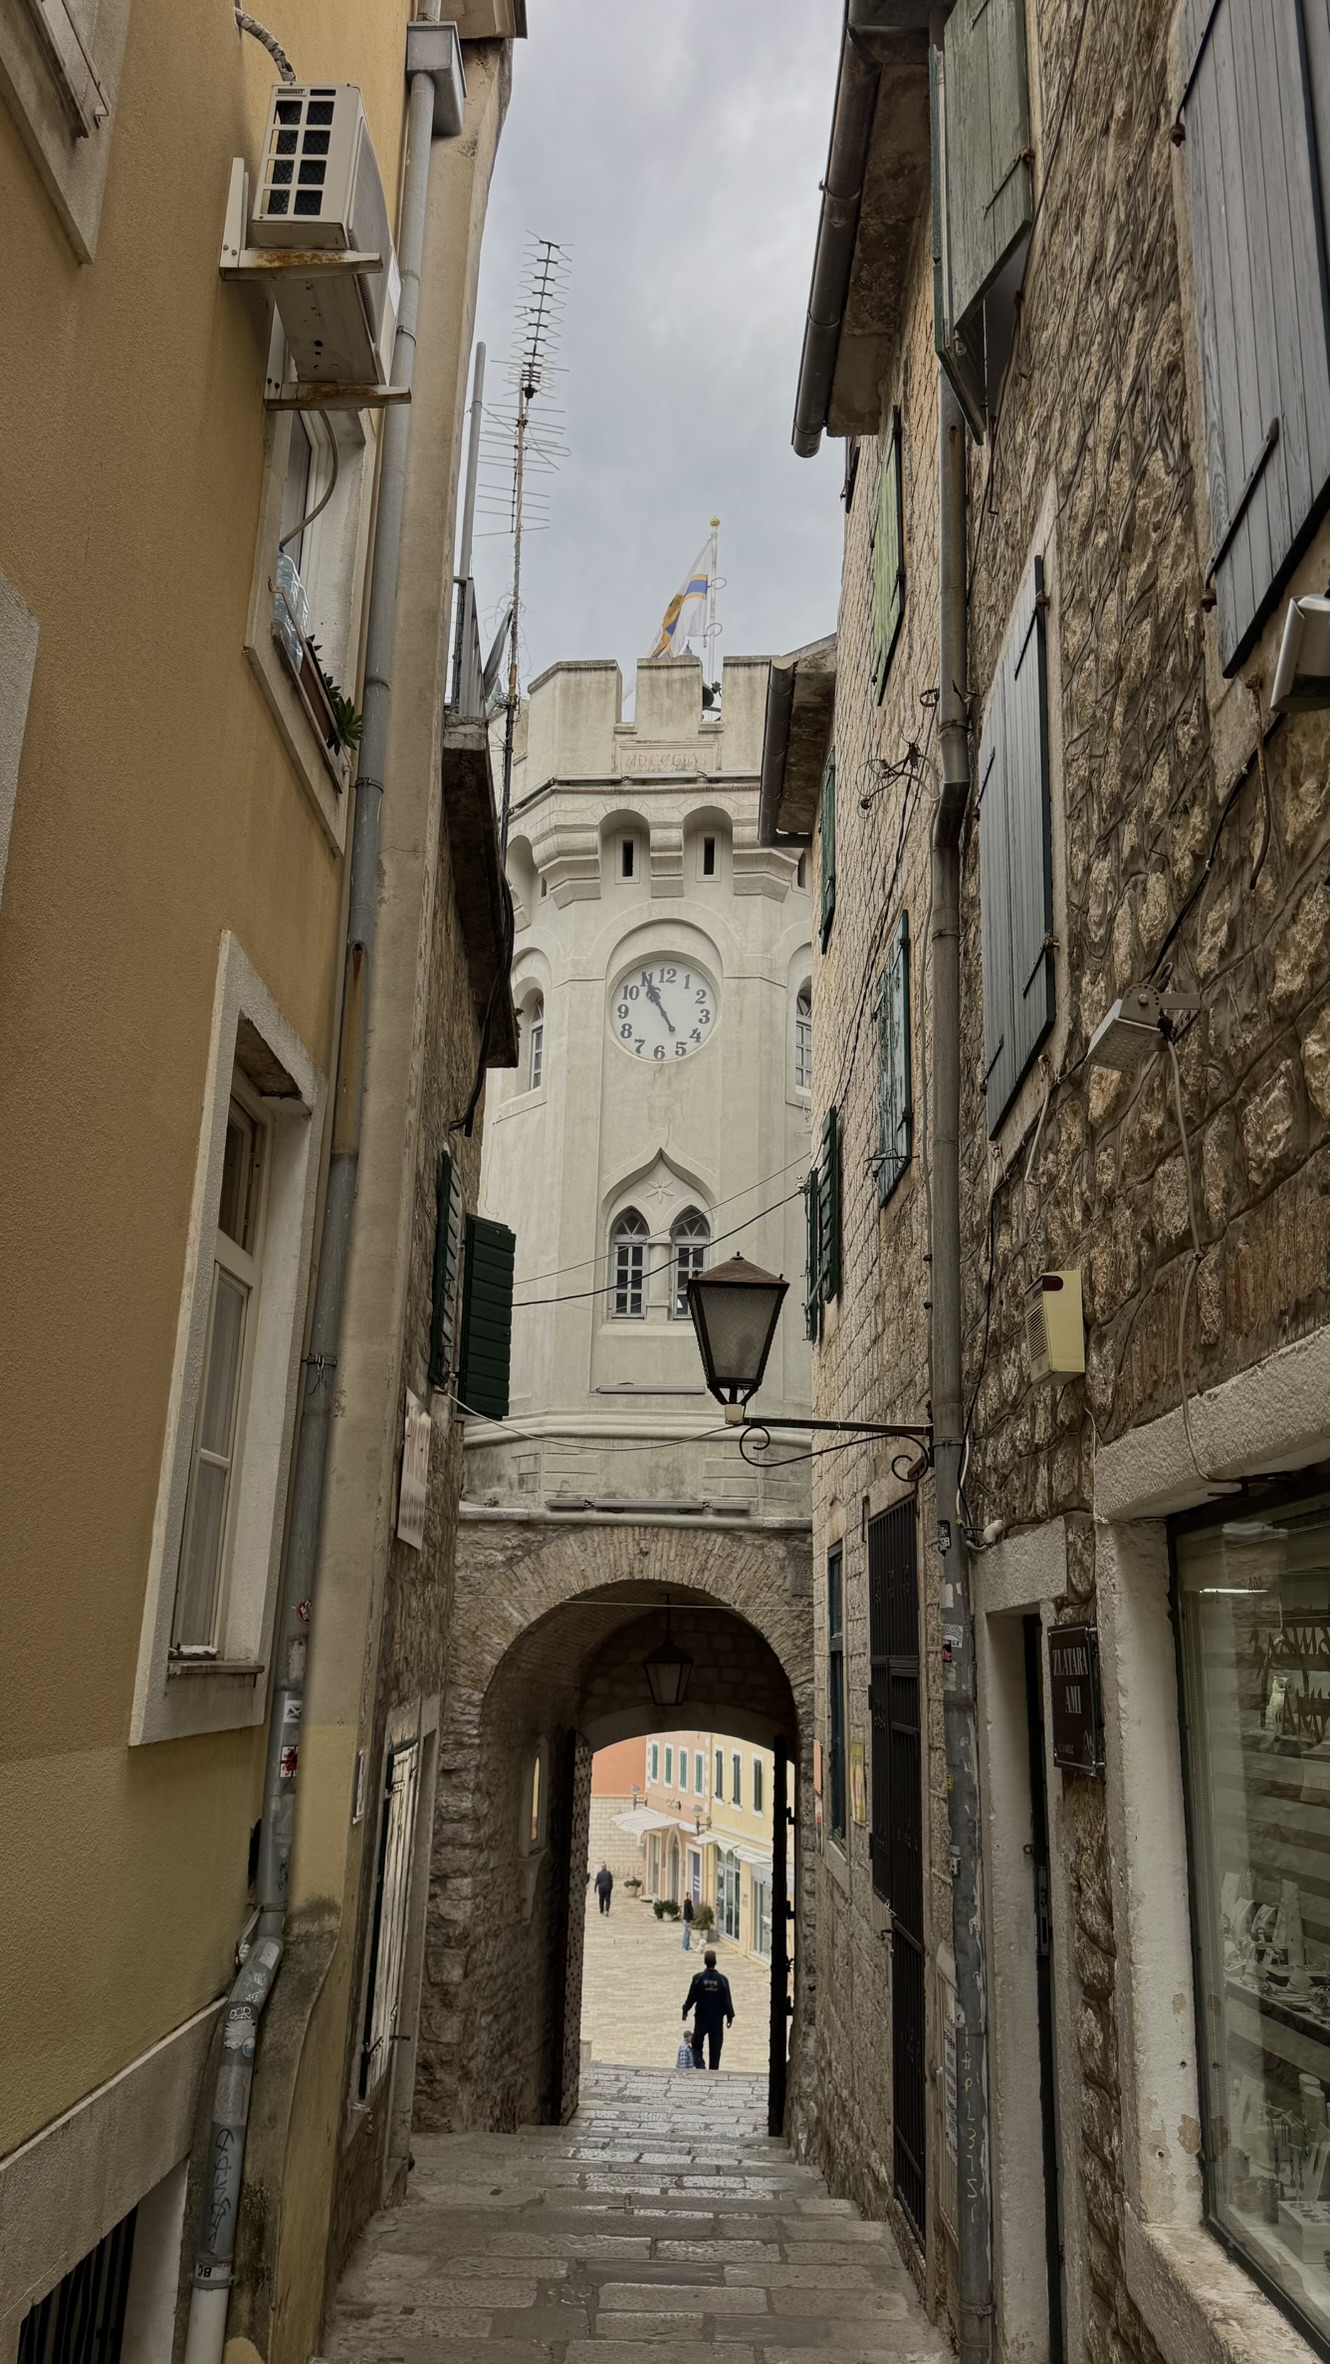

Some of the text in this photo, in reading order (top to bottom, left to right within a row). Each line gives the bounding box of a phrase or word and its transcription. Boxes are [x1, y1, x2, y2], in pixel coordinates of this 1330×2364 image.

[658, 968, 677, 984] 12
[684, 973, 691, 990] 1
[622, 984, 640, 1001] 10
[695, 989, 707, 1005] 2
[617, 1004, 629, 1019] 9
[698, 1009, 710, 1024] 3
[620, 1023, 632, 1039] 8
[689, 1027, 702, 1043] 4
[634, 1039, 645, 1054] 7
[653, 1045, 665, 1060] 6
[675, 1041, 687, 1056] 5
[1052, 1646, 1089, 1676] ZLATARA
[1065, 1685, 1083, 1714] AMI
